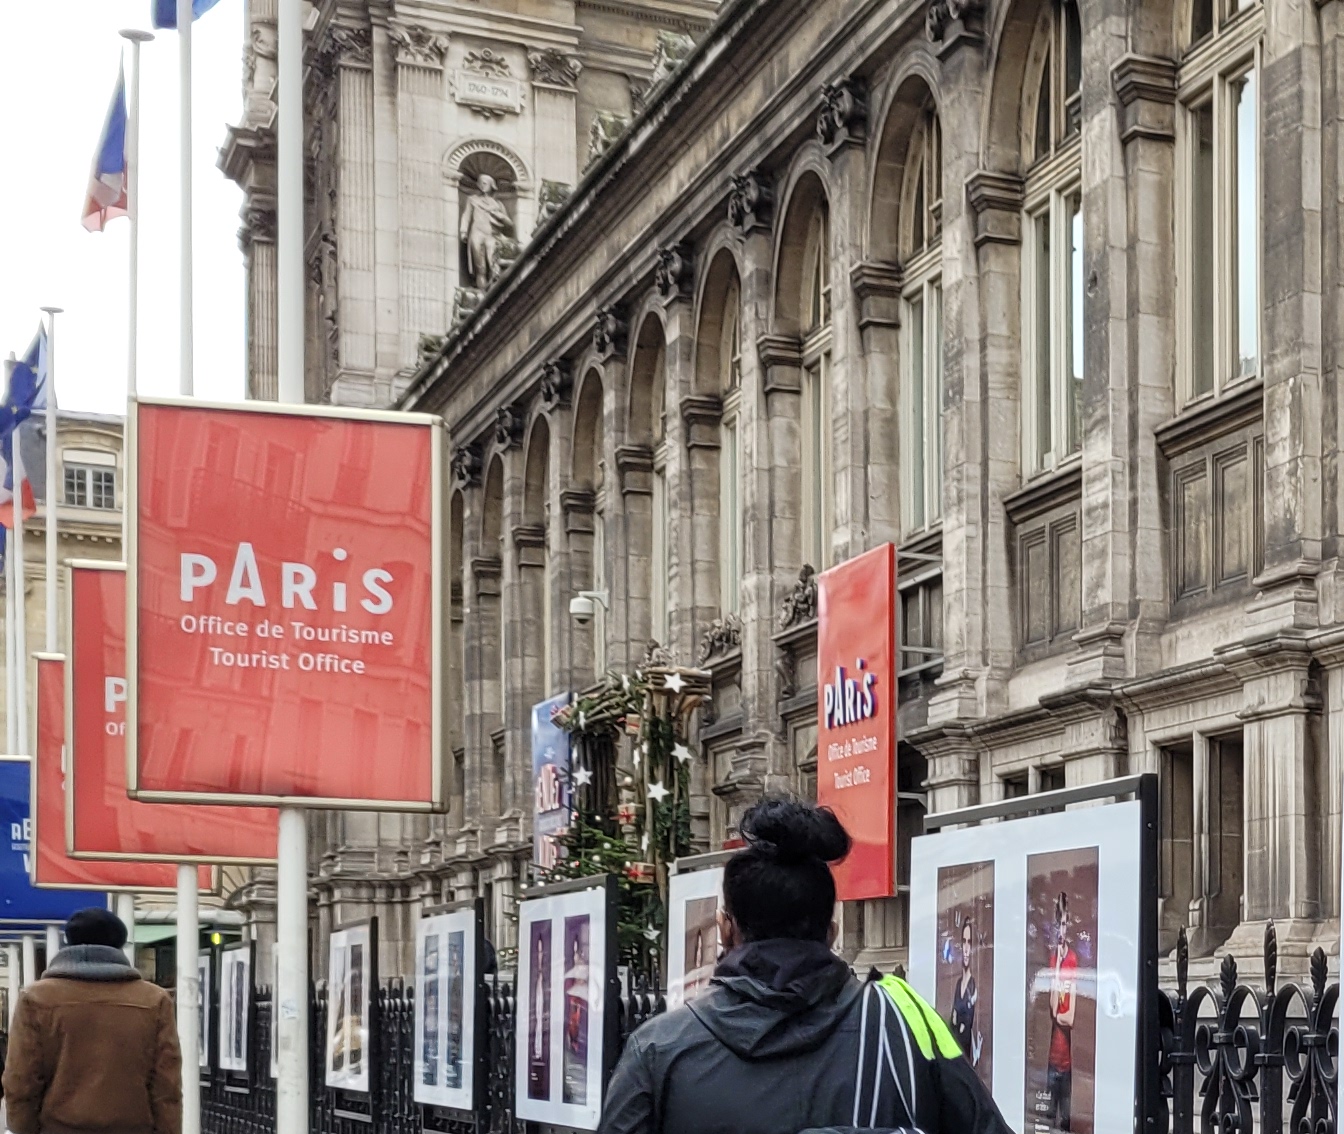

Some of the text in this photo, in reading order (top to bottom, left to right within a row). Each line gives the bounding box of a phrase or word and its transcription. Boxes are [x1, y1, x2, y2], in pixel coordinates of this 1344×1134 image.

[180, 614, 394, 646] Office de Tourisme
[208, 646, 366, 675] Tourist Office
